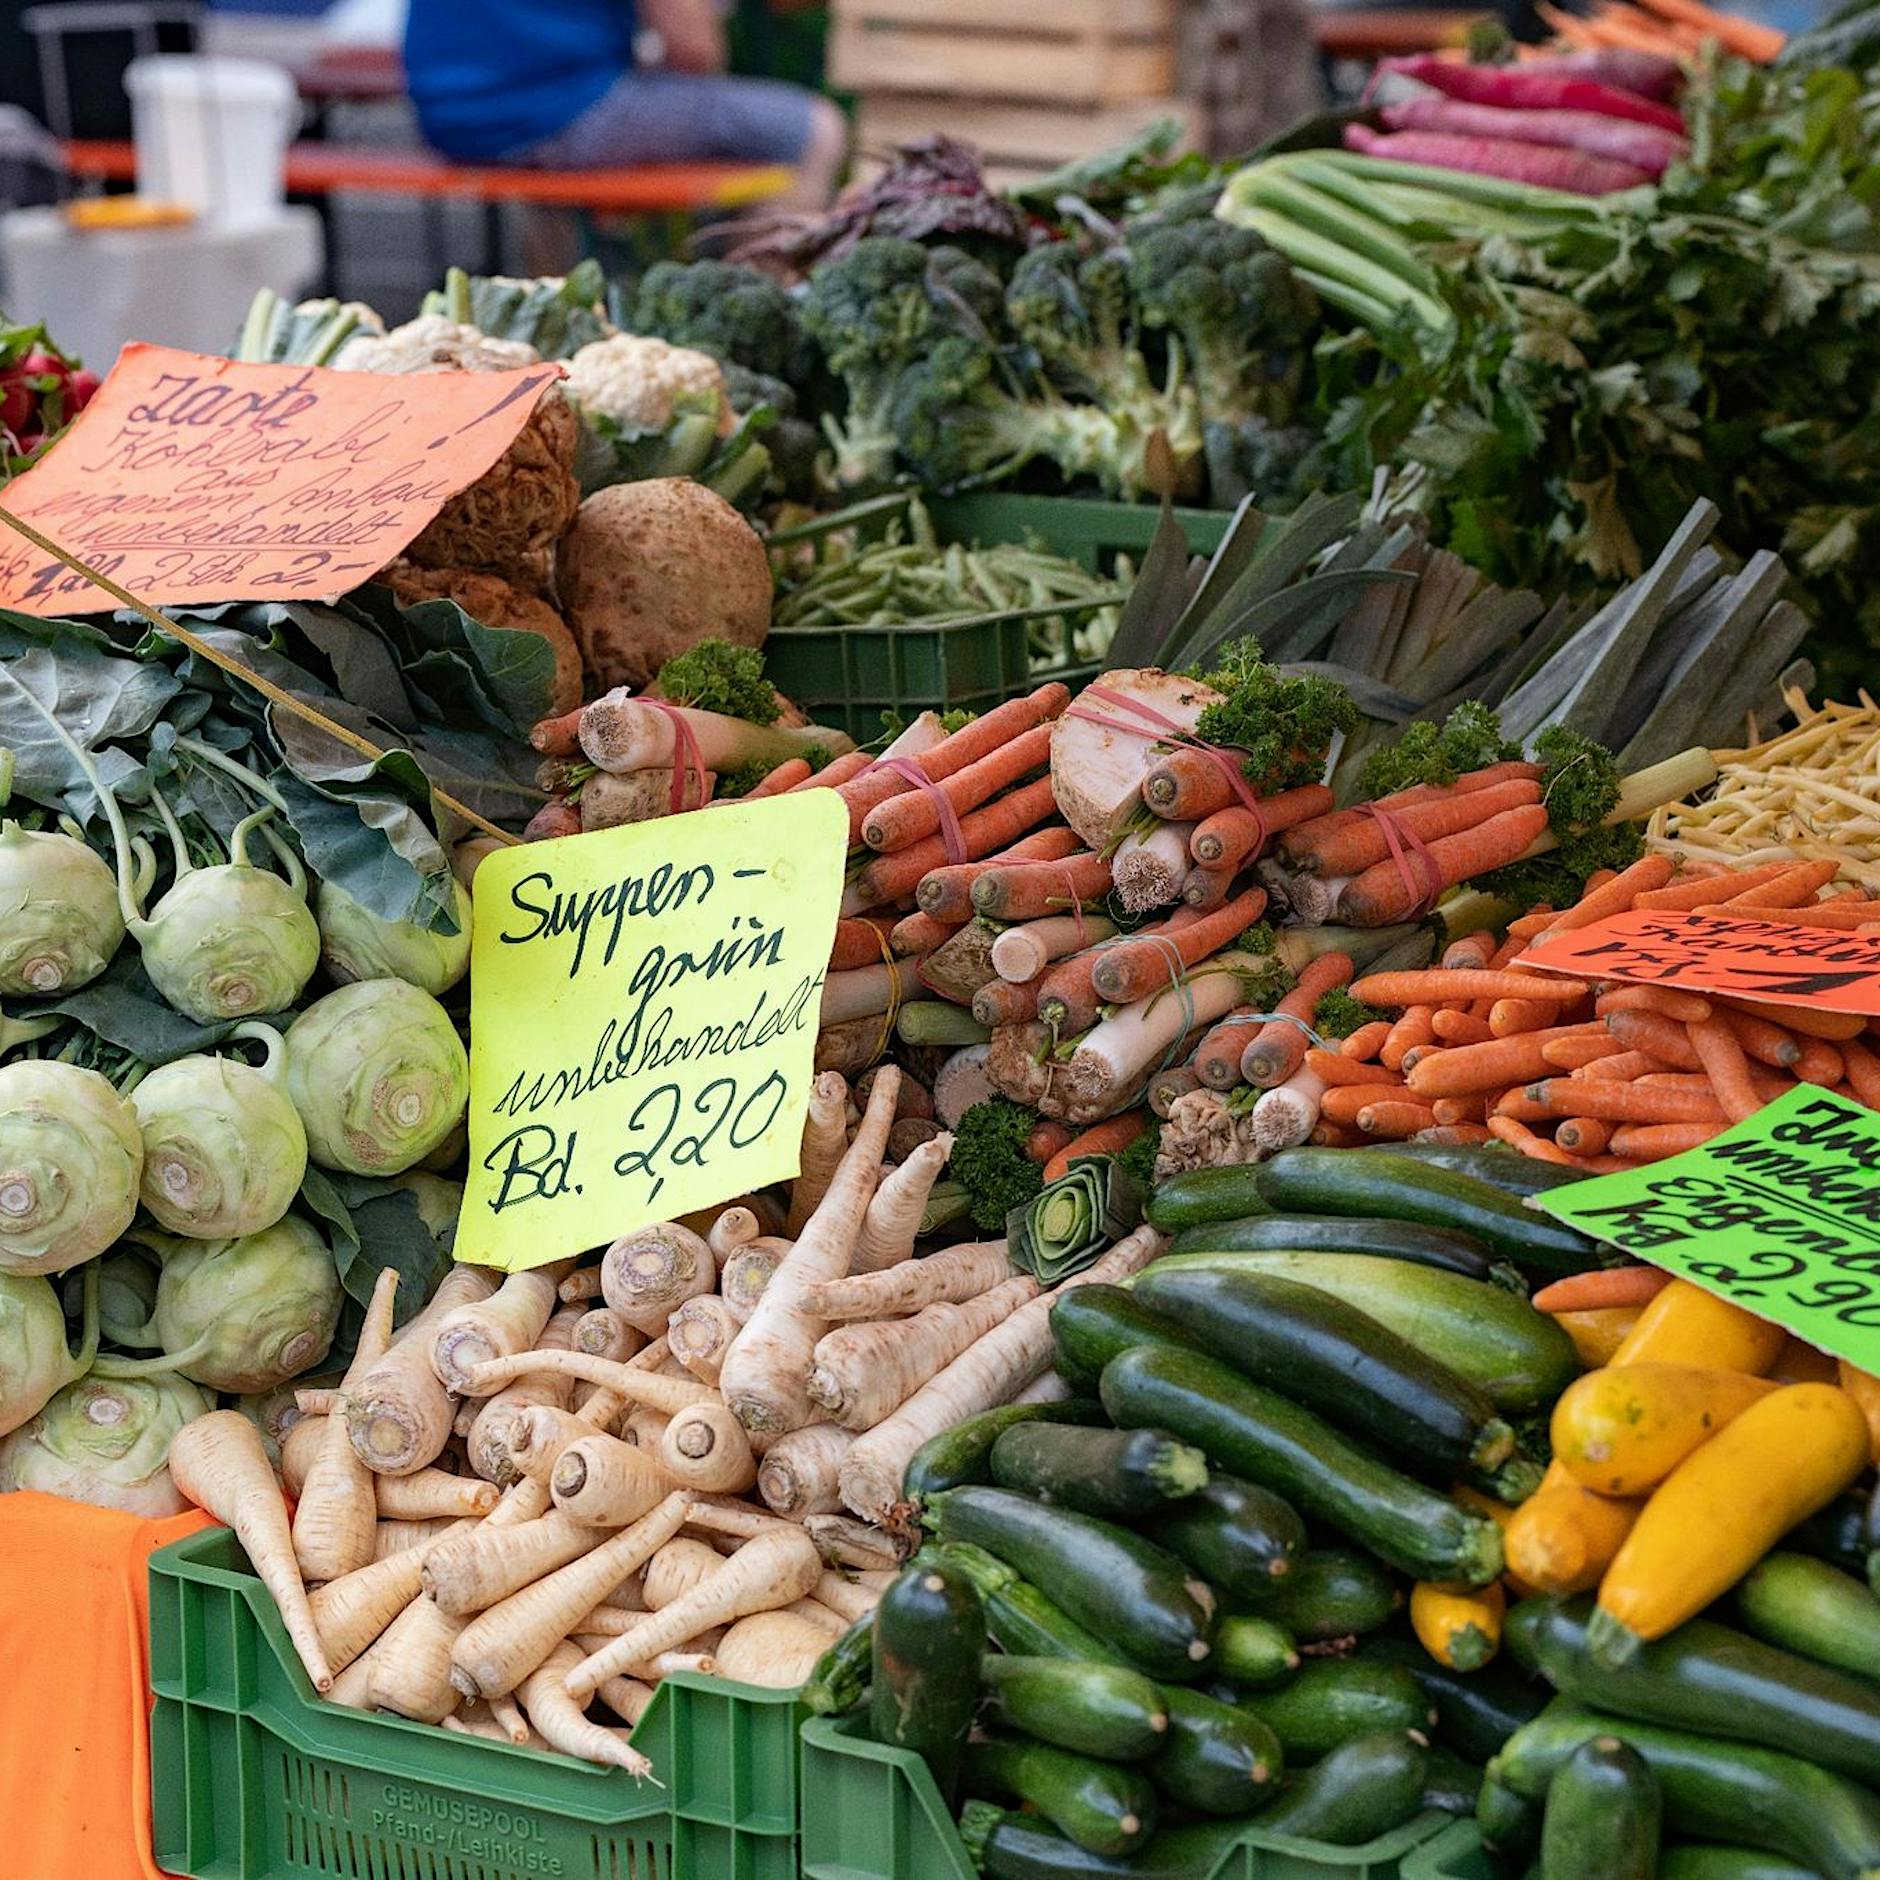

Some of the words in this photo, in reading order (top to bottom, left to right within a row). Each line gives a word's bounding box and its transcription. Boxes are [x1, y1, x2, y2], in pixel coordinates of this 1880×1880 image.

[128, 371, 317, 427] Zarte
[82, 400, 412, 472] Kohlrabi
[17, 482, 255, 534] eigenem
[267, 460, 448, 515] Anbau
[174, 467, 279, 492] aus
[67, 508, 402, 545] unbehandelt
[615, 916, 785, 1063] grün
[493, 967, 824, 1117] unbehandelt
[484, 1123, 583, 1213] Bd.
[614, 1069, 787, 1204] 2,20
[372, 1809, 563, 1876] Pfand-/Leihkiste
